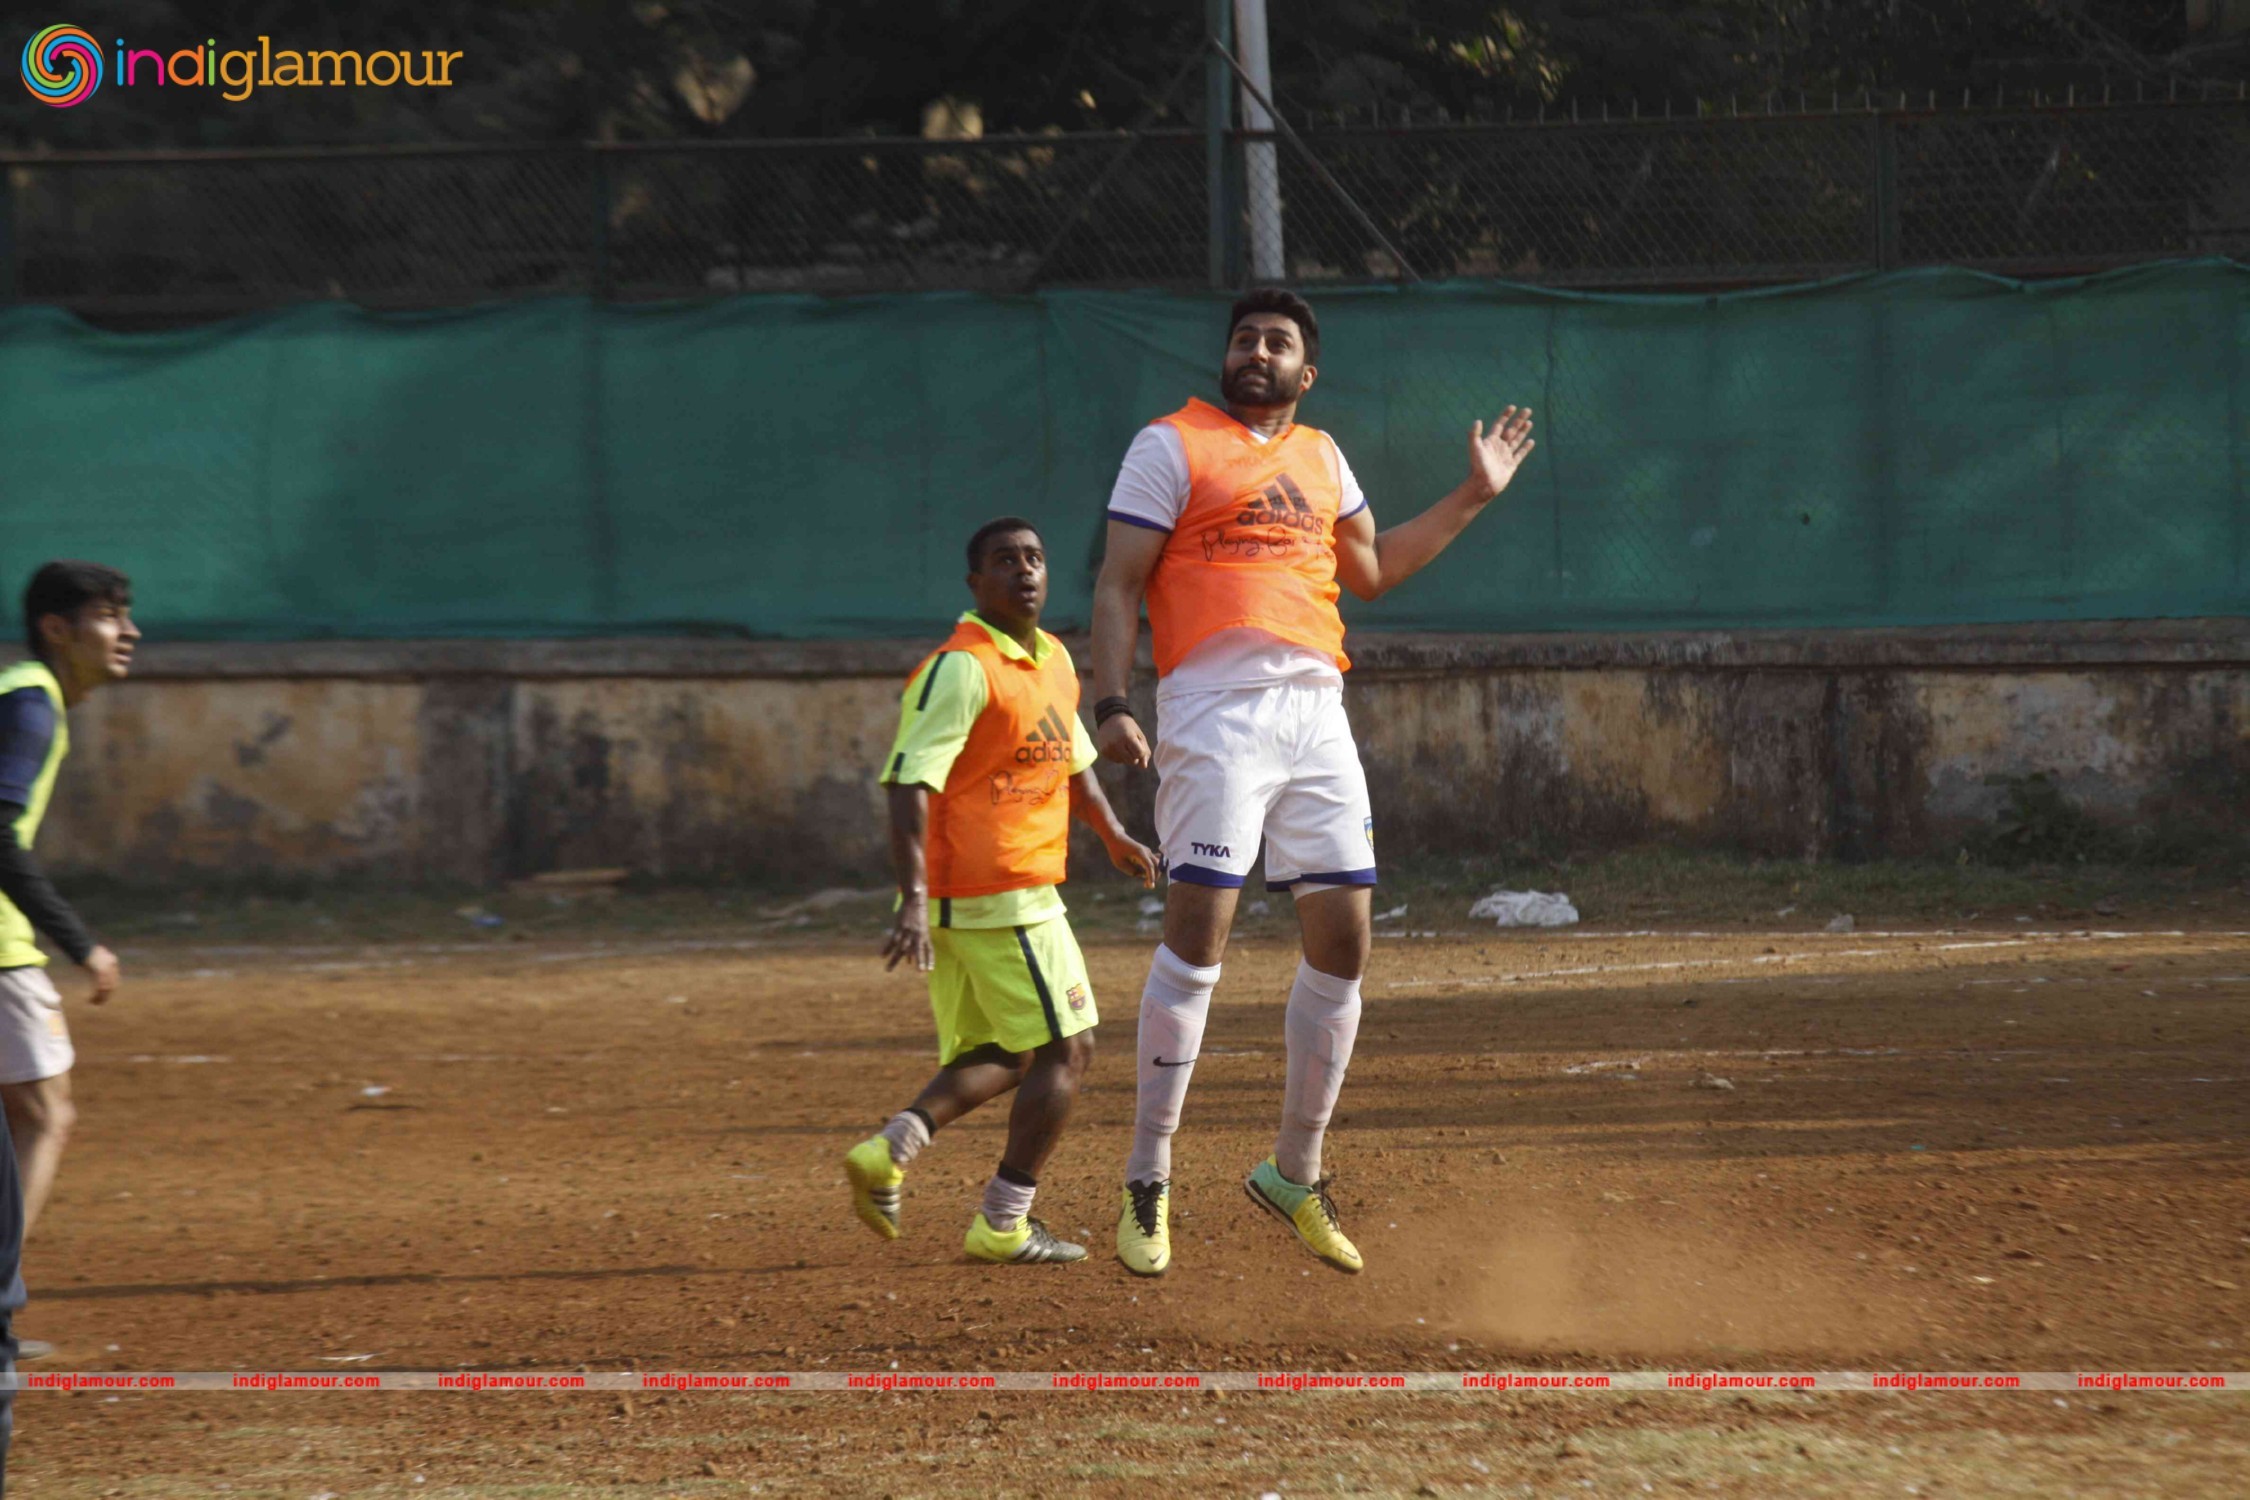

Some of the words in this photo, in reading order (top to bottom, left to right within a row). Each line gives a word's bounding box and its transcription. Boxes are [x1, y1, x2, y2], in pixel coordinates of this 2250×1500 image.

[1237, 508, 1324, 535] adidas
[1015, 741, 1071, 764] adida
[1191, 841, 1231, 858] TYKA
